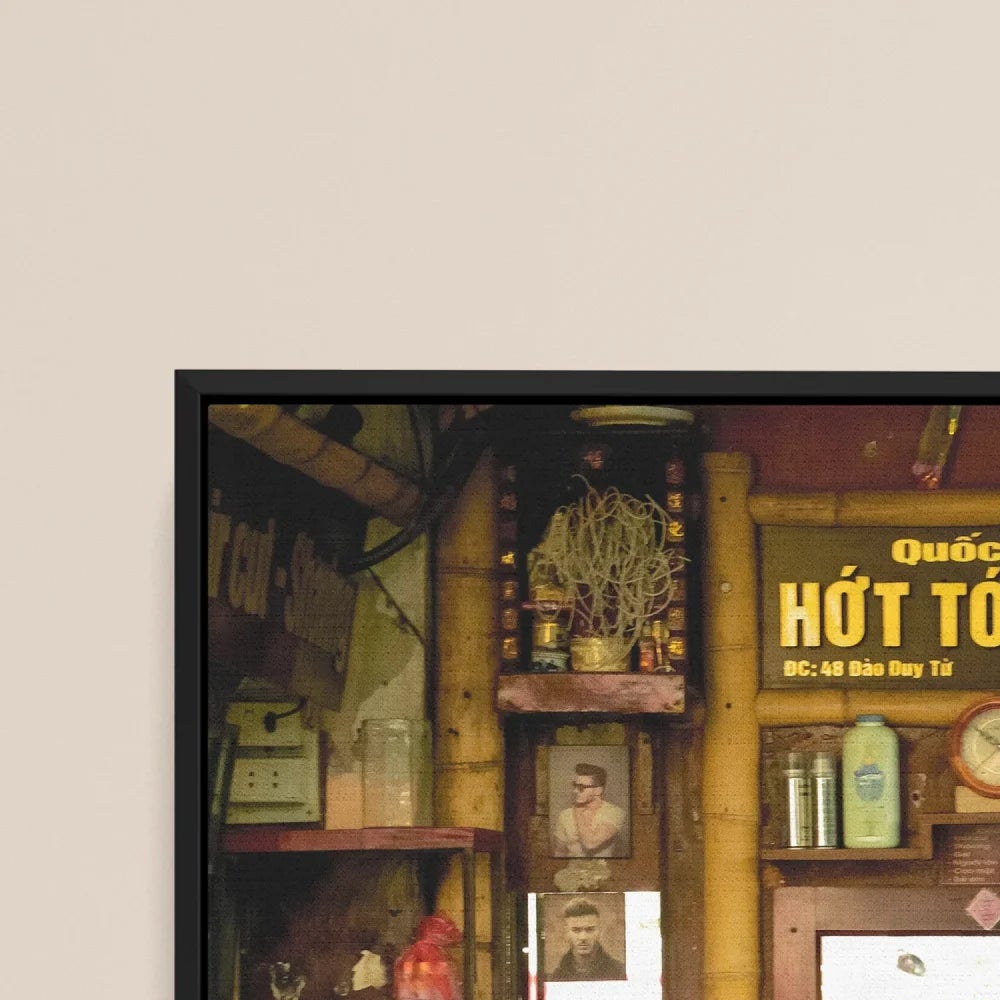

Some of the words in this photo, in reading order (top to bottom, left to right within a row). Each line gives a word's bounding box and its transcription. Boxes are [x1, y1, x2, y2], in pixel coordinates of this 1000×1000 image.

[778, 565, 910, 648] HỚT
[820, 661, 844, 677] 48
[888, 660, 924, 679] Duy
